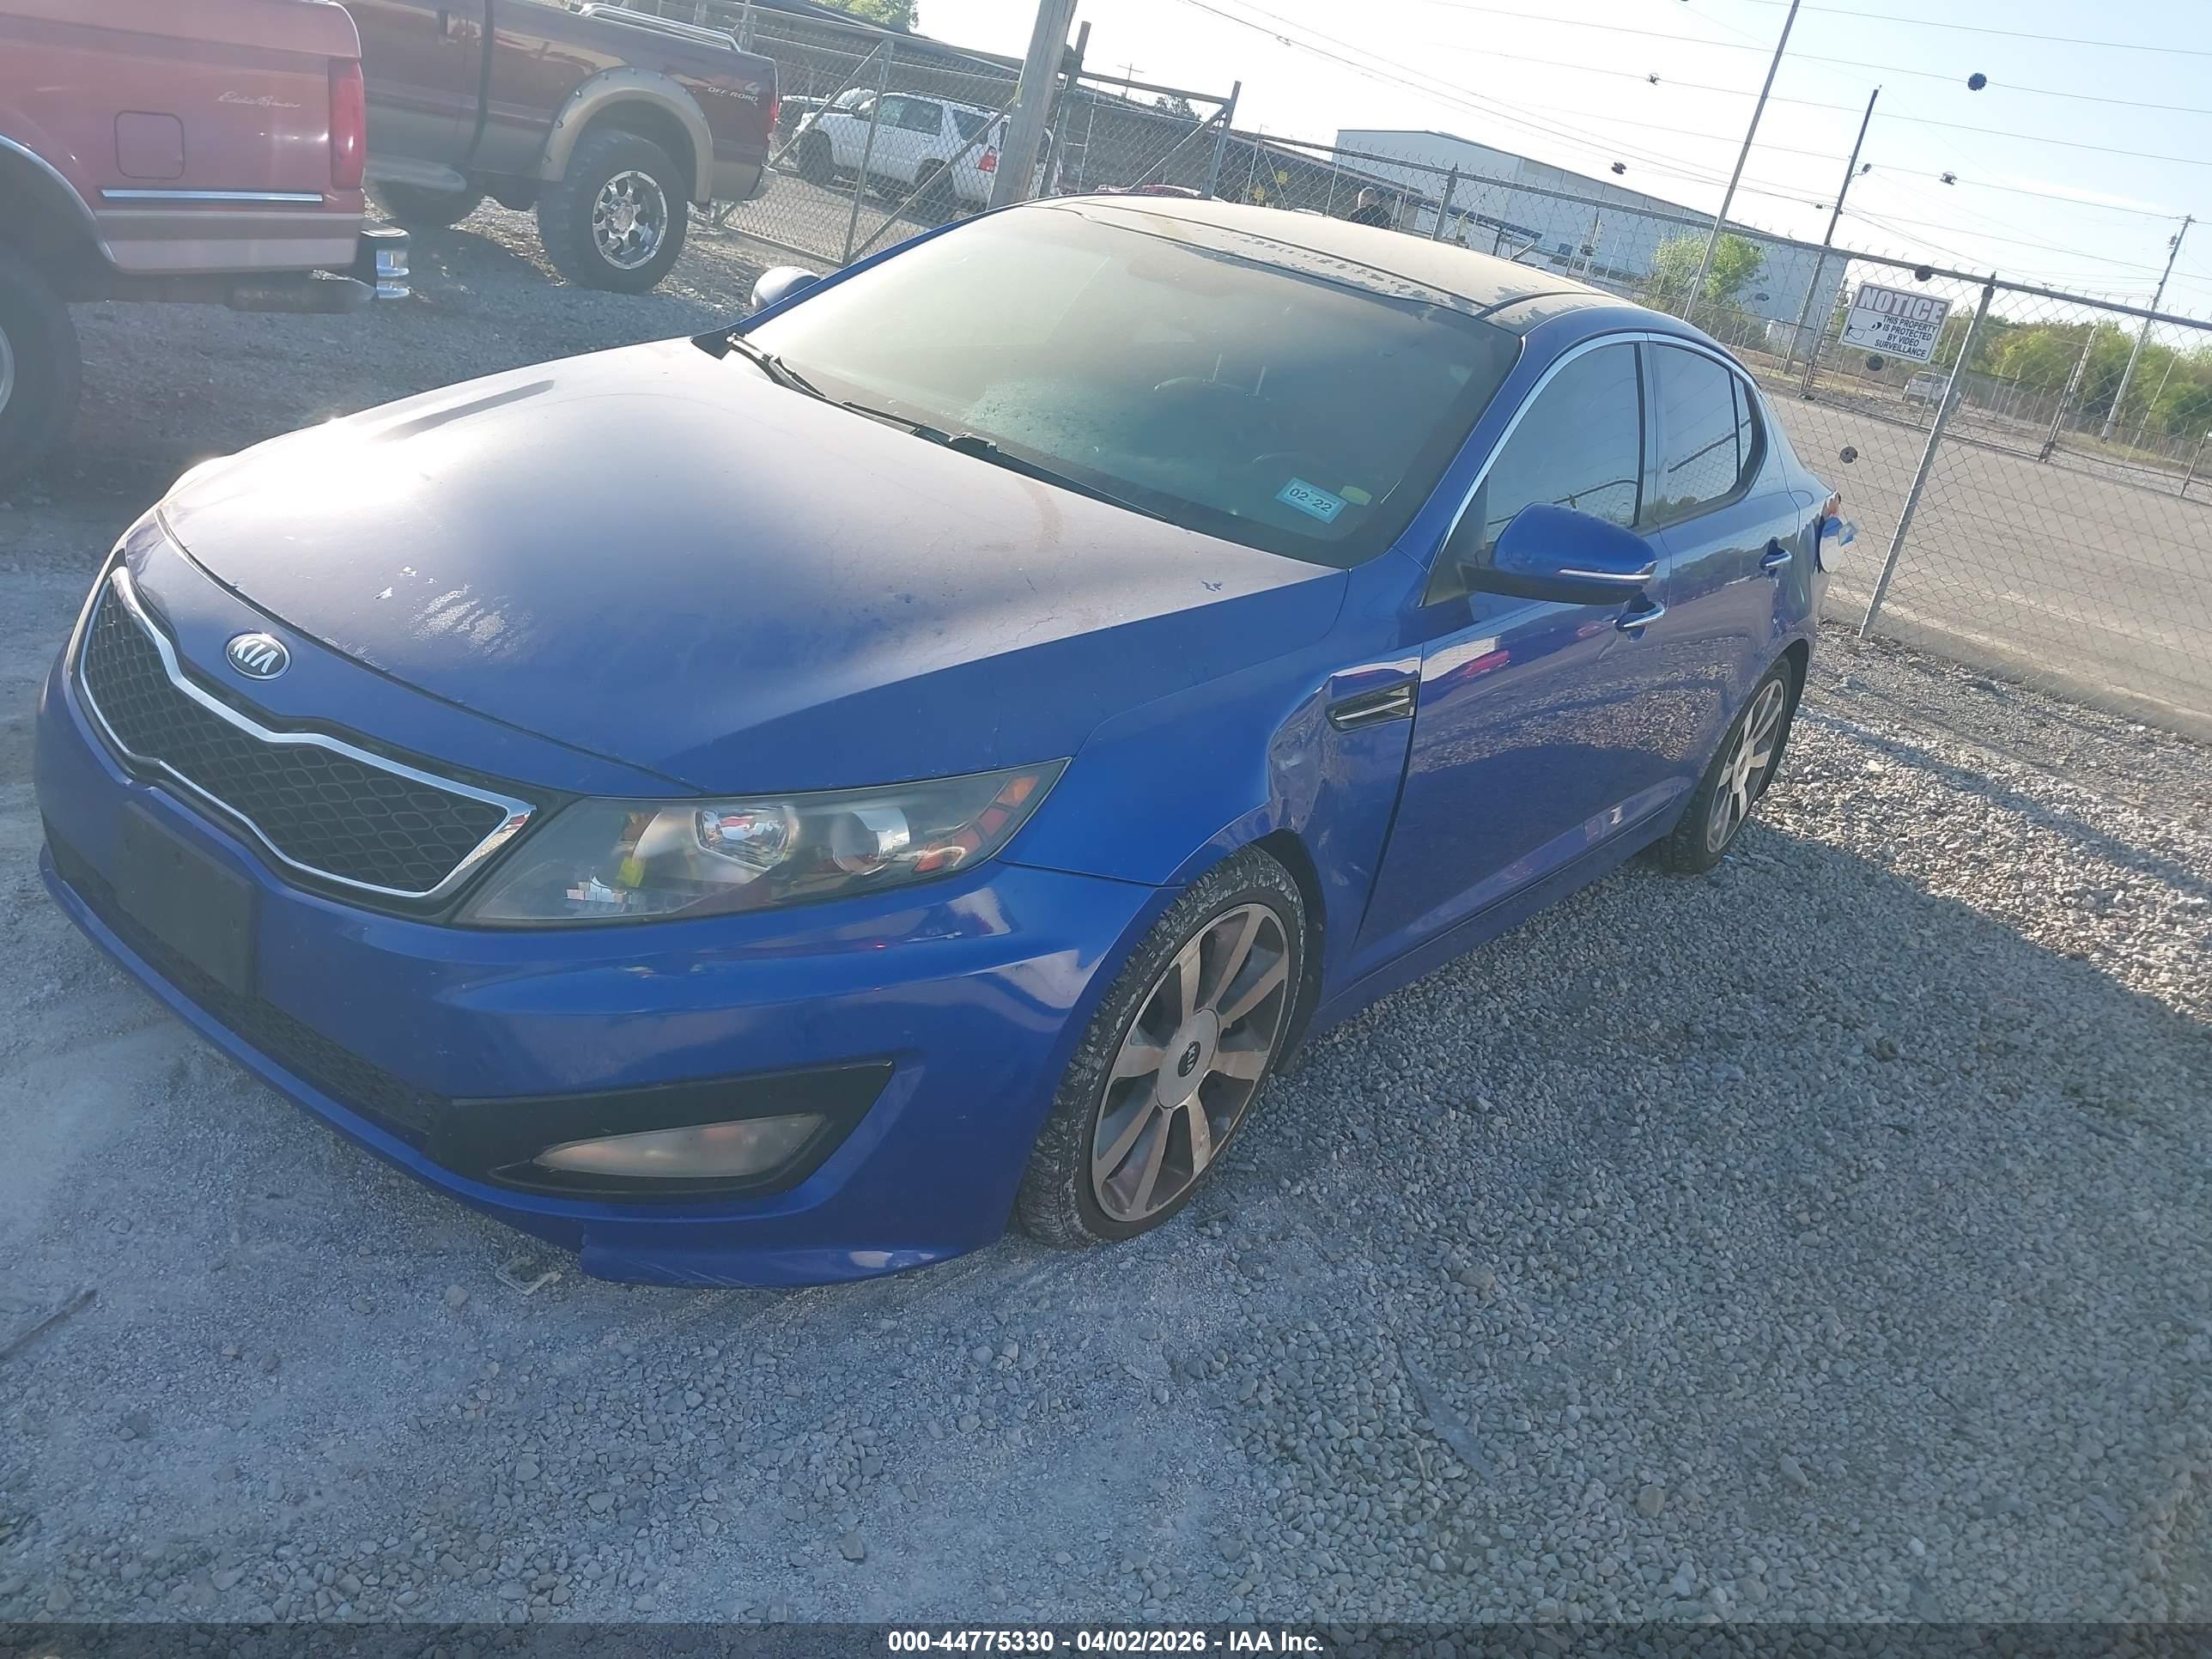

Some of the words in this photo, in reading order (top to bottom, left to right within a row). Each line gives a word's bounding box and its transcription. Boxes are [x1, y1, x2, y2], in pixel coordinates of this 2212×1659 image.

[707, 87, 727, 95] OFF
[729, 91, 759, 102] ROAD
[1857, 287, 1947, 325] NOTICE
[1881, 323, 1890, 332] IS
[1891, 325, 1933, 341] PROTECTED
[1882, 314, 1898, 325] THIS
[1899, 318, 1938, 334] PROPERTY
[1875, 339, 1927, 357] SURVEILLANCE
[1887, 333, 1898, 342] BY
[1898, 336, 1920, 347] VIDEO
[1289, 488, 1309, 501] 02
[1311, 499, 1333, 513] 22
[230, 639, 278, 674] KIA
